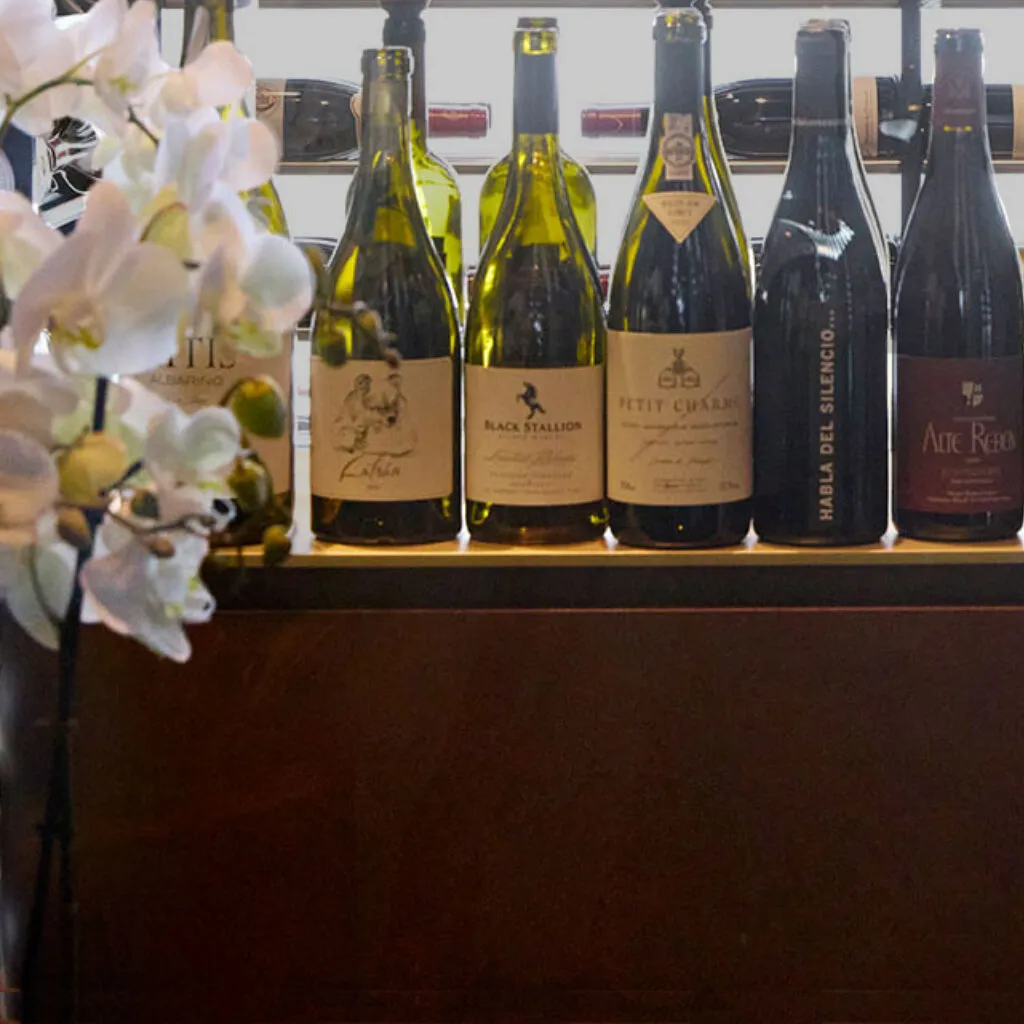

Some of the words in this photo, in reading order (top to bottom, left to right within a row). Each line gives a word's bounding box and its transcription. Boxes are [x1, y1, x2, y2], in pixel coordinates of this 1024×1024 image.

[819, 310, 835, 413] SILENCIO...
[484, 419, 518, 432] BLACK
[523, 420, 582, 433] STALLION
[819, 421, 834, 454] DEL
[819, 461, 834, 521] HABLA
